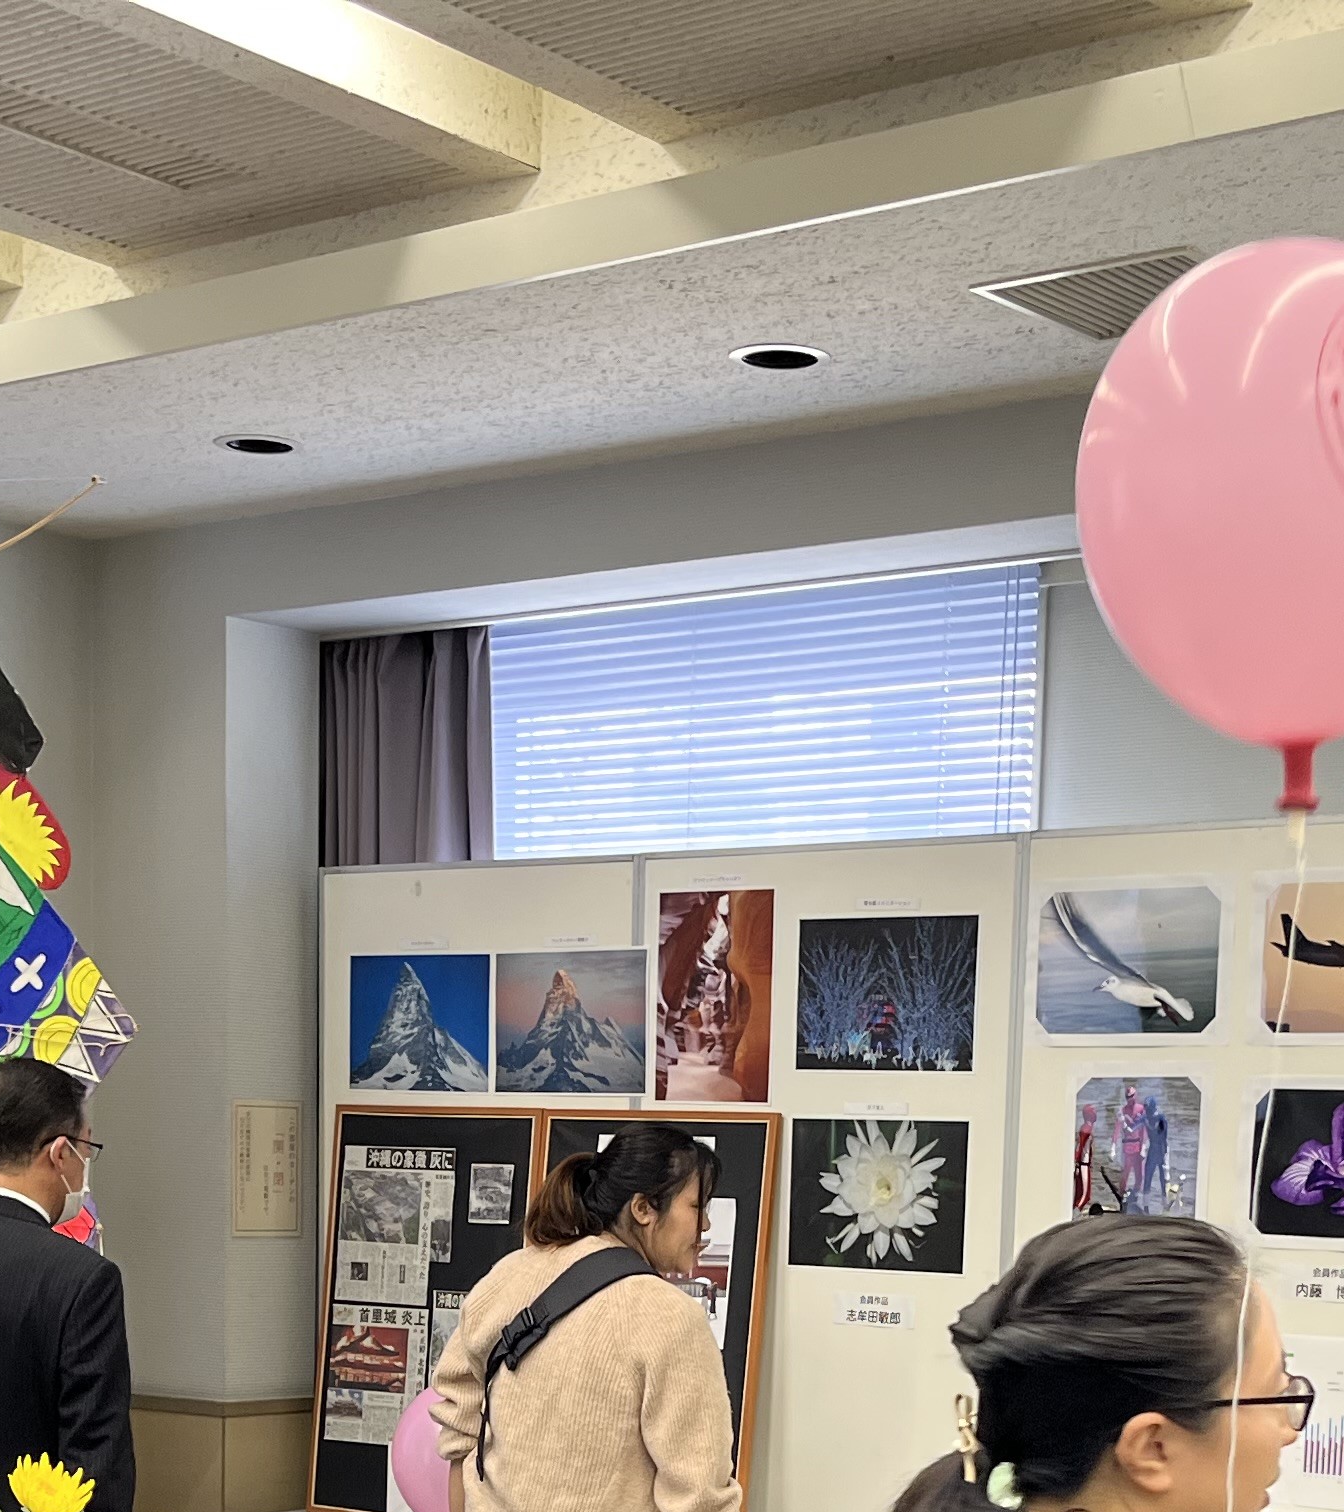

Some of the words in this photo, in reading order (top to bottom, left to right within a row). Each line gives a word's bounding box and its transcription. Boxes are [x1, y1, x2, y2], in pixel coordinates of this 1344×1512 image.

[368, 1149, 426, 1168] 沖縄の象徴
[430, 1151, 453, 1169] 灰に
[1296, 1283, 1322, 1298] 内藤
[359, 1308, 397, 1324] 首里城
[401, 1310, 426, 1327] 炎上
